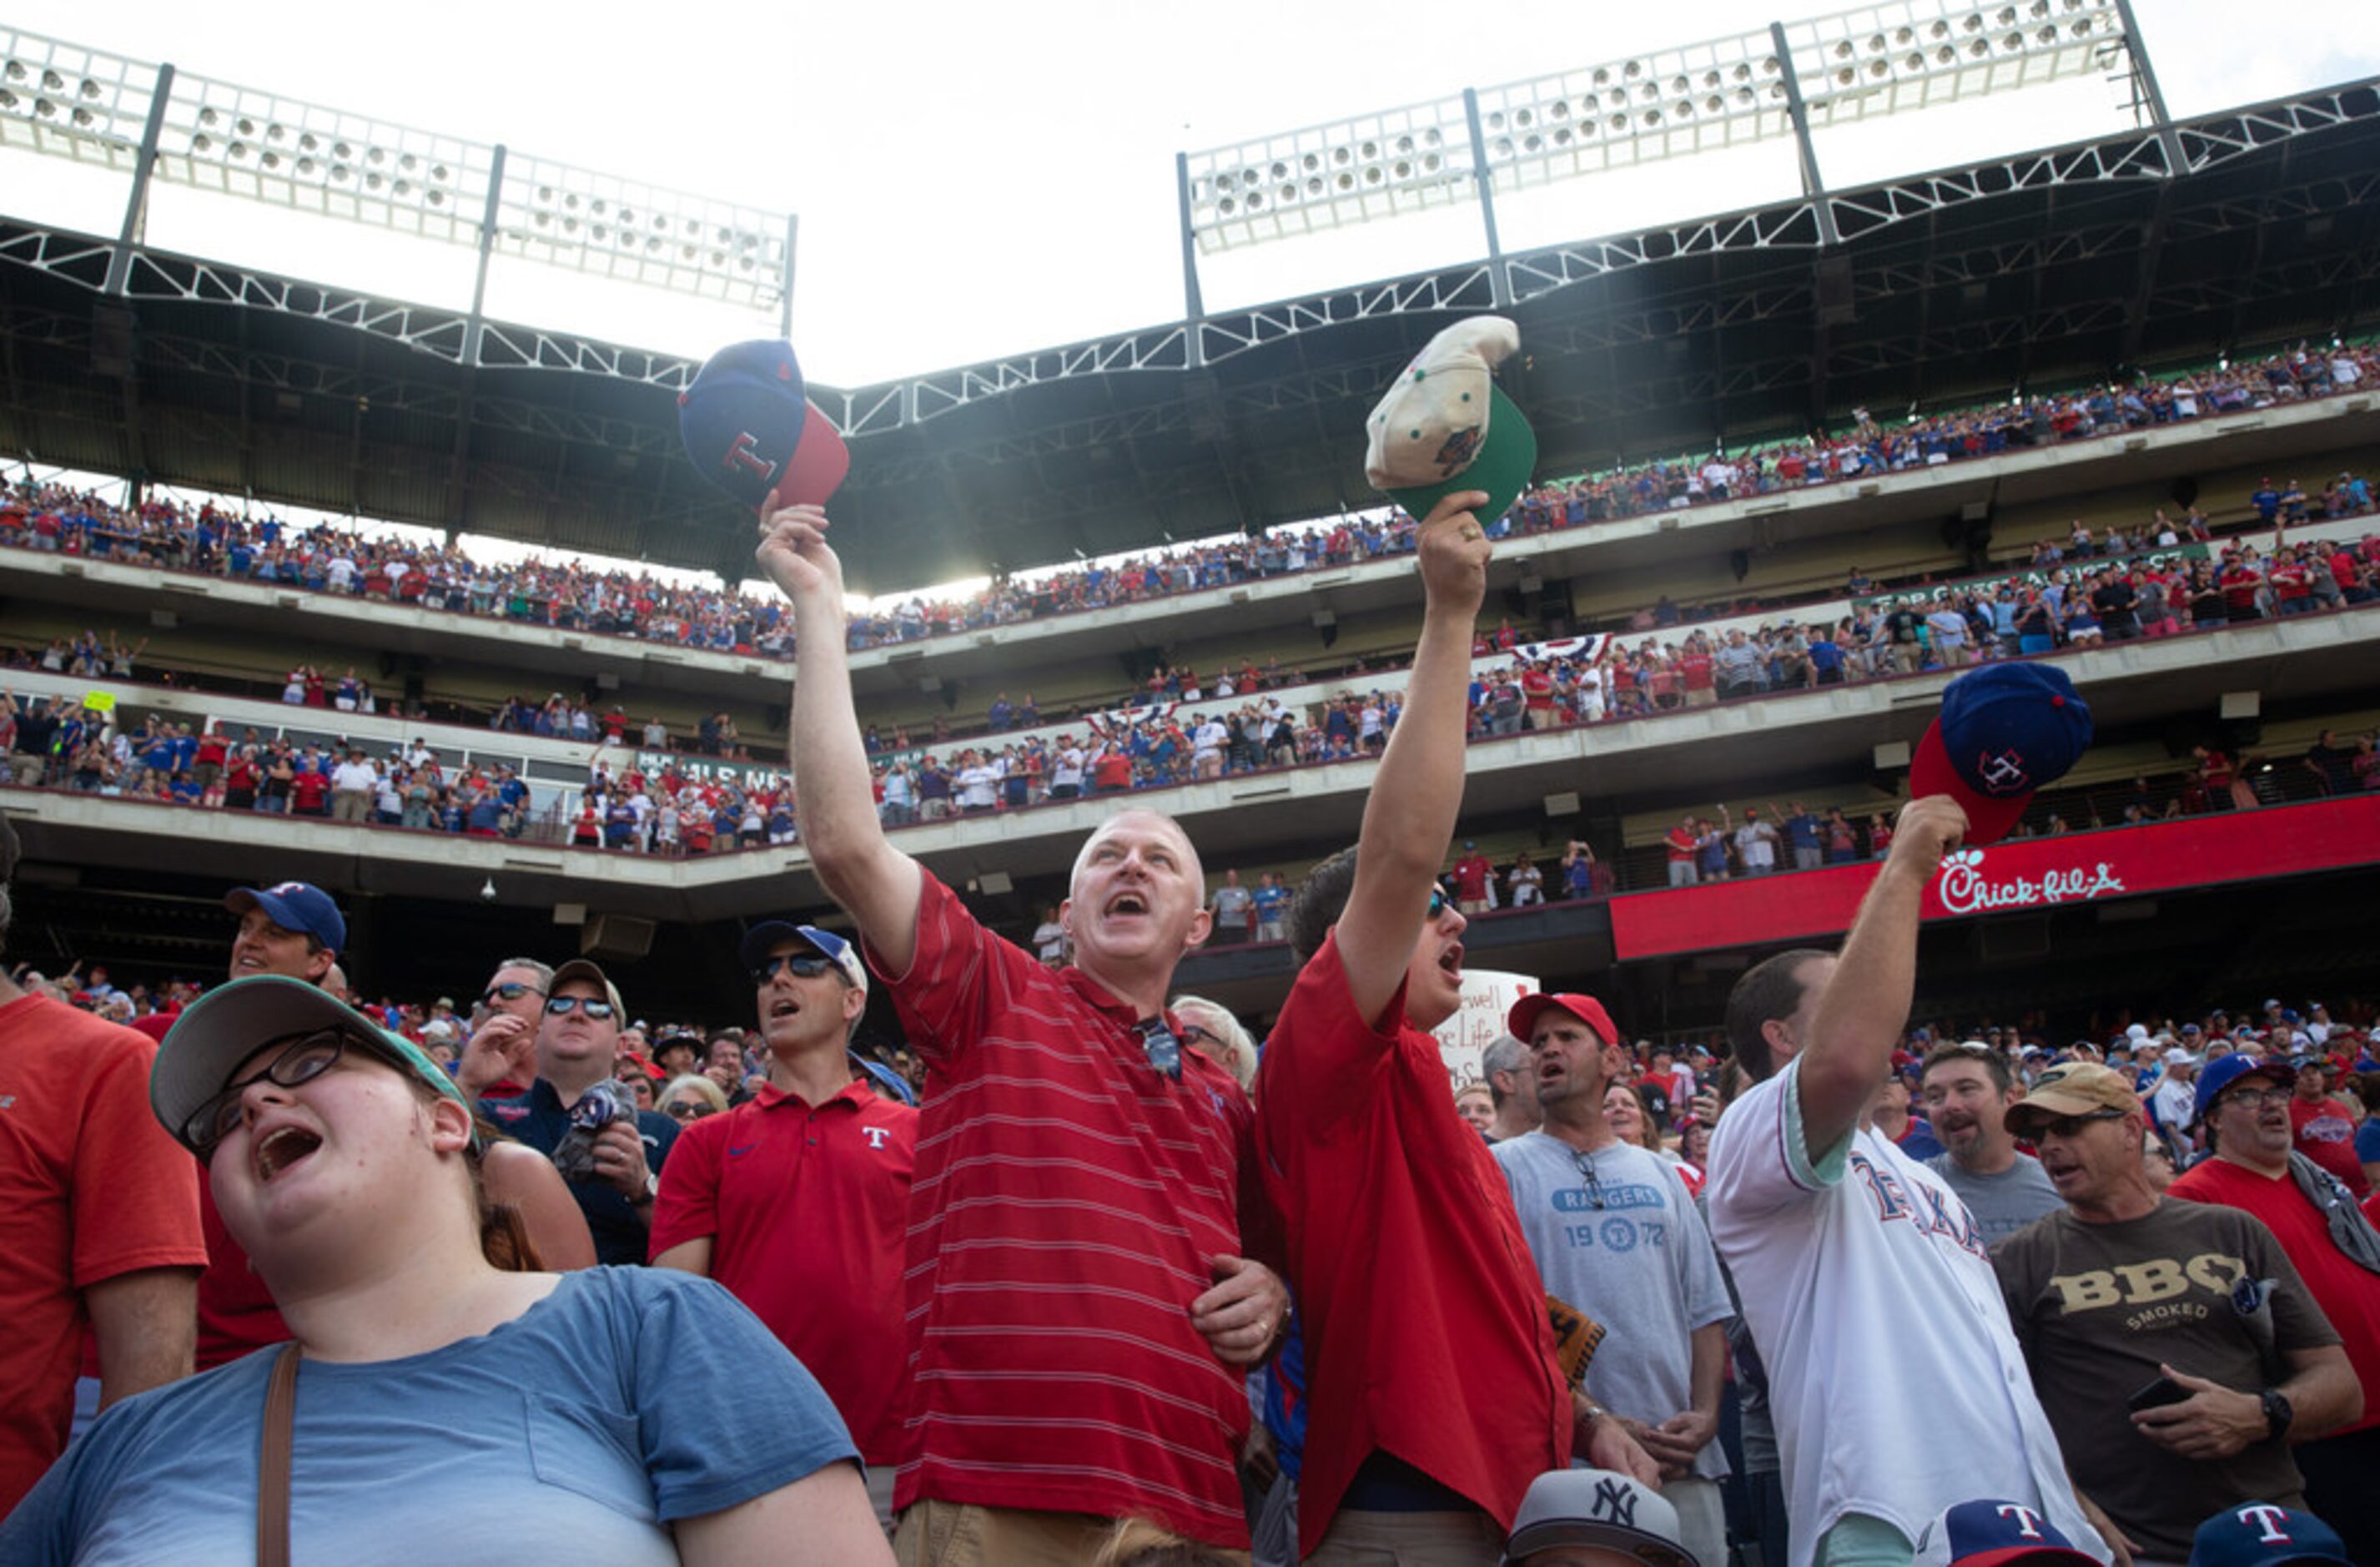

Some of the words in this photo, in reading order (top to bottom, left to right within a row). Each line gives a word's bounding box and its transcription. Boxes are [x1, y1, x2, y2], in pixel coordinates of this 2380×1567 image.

[722, 431, 777, 481] T
[1940, 859, 2126, 912] Chick-fil-A
[862, 1126, 892, 1151] T
[1564, 1224, 1593, 1247] 19
[1640, 1222, 1665, 1246] 72
[2050, 1253, 2247, 1315] BBQ
[1591, 1476, 1638, 1526] NY
[1995, 1504, 2045, 1543] T
[2237, 1505, 2292, 1545] T
